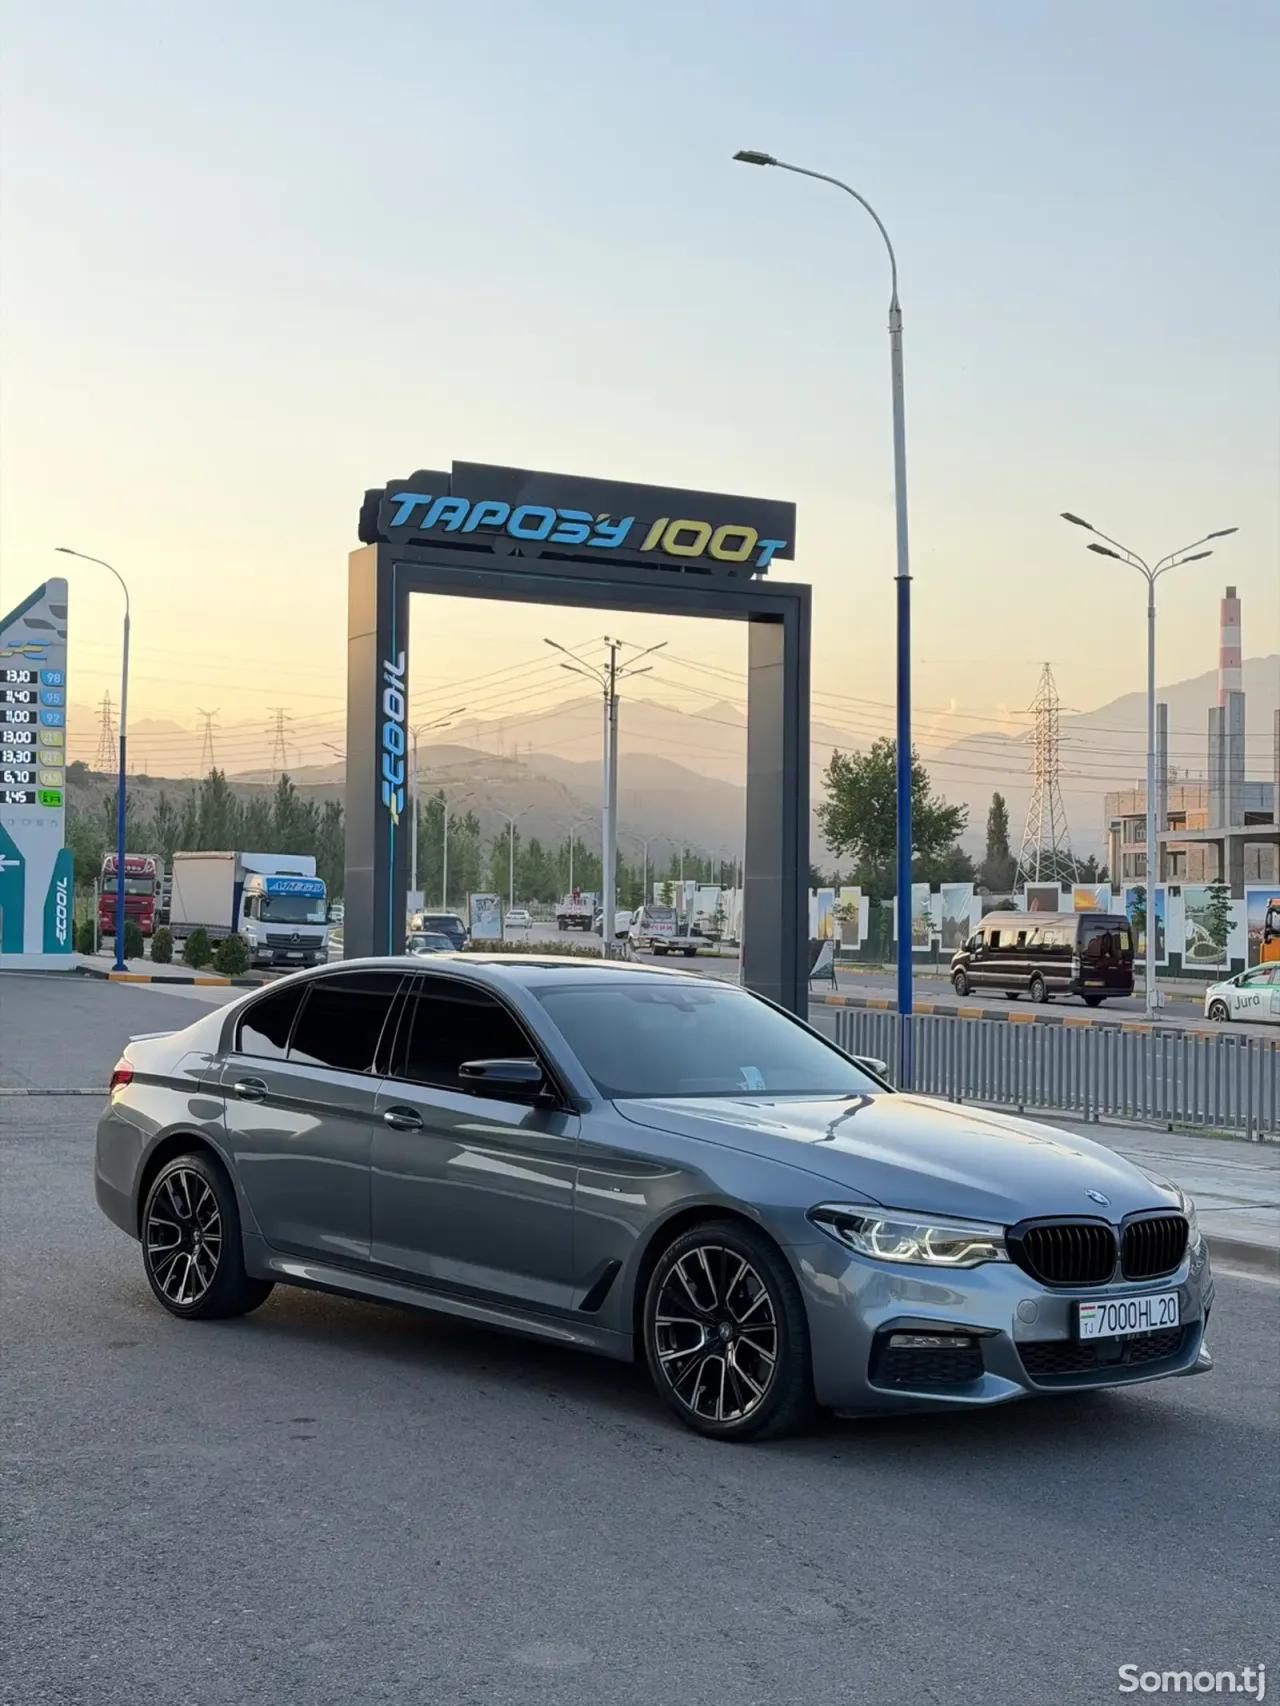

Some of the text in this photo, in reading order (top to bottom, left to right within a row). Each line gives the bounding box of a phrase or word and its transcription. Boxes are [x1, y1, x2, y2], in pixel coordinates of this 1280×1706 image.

[47, 672, 61, 683] 98
[46, 713, 60, 723] 92
[1097, 1297, 1176, 1334] 7000HL20
